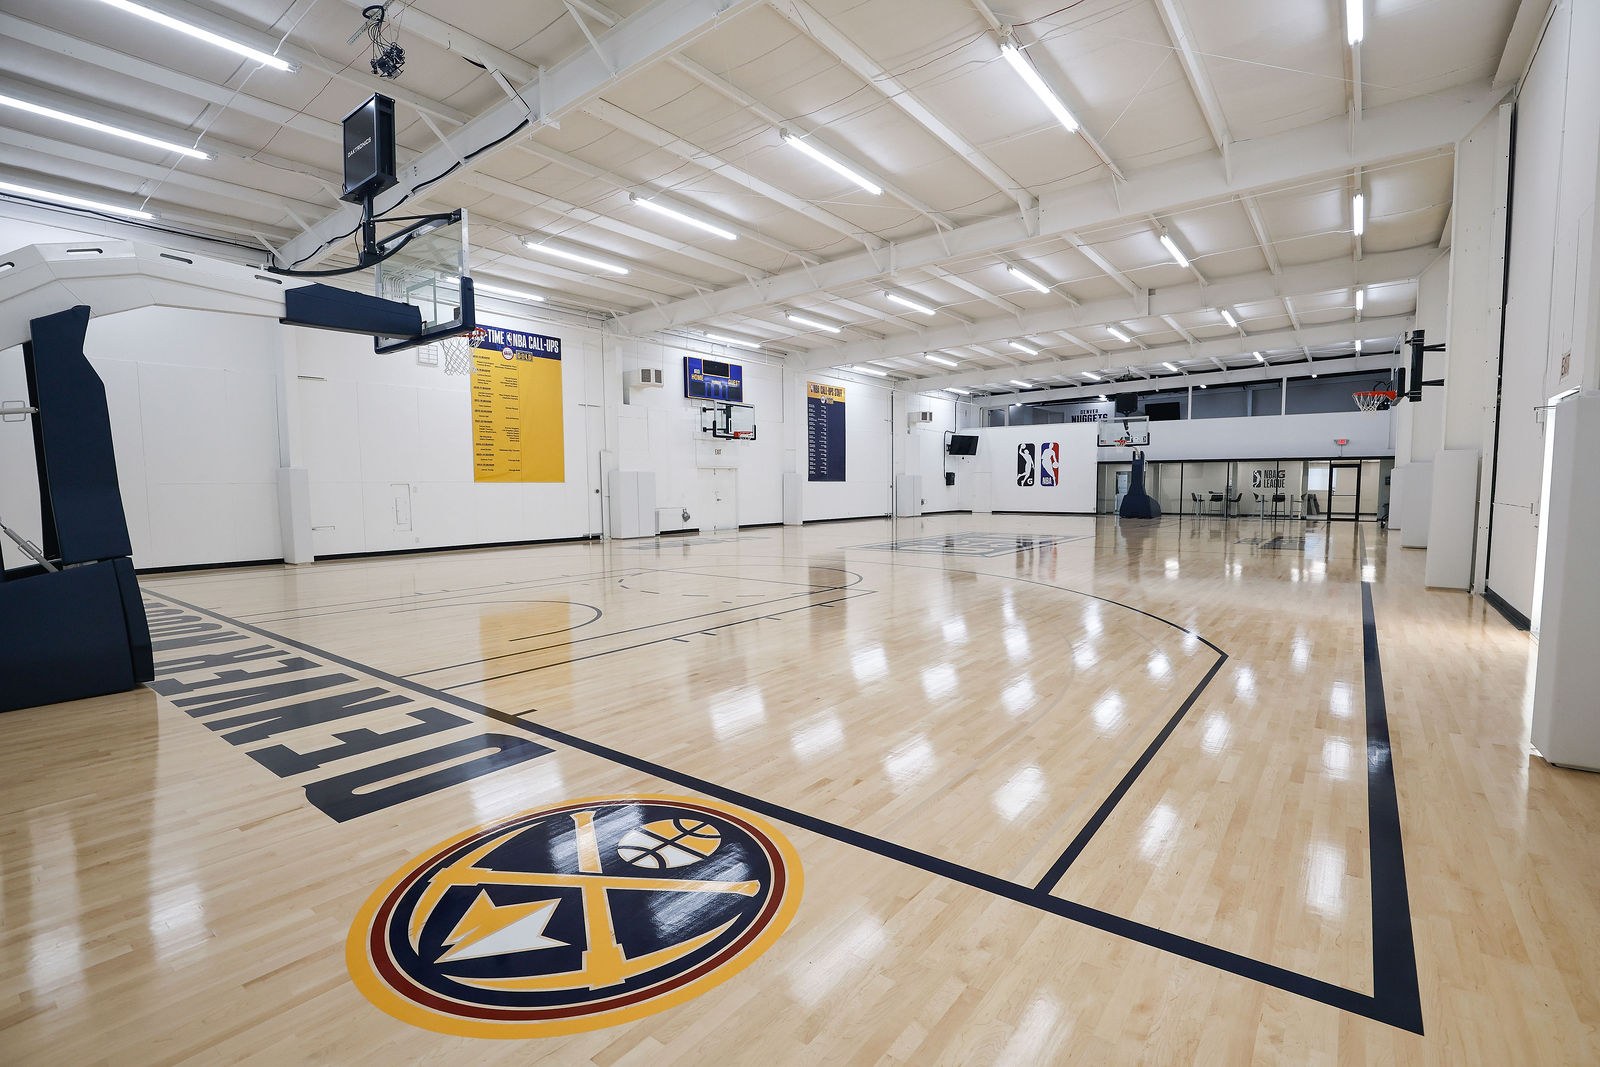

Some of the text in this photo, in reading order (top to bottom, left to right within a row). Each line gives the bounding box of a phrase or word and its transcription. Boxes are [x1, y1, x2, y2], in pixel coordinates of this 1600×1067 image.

[347, 136, 372, 158] DAKTRONICS
[512, 333, 527, 349] NBA
[528, 336, 559, 353] CALL-UPS
[1071, 413, 1108, 423] NUGGETS
[1263, 470, 1277, 478] NBA
[1042, 476, 1053, 485] NBA
[1263, 479, 1285, 488] LEAGUE
[146, 641, 557, 824] DENVER
